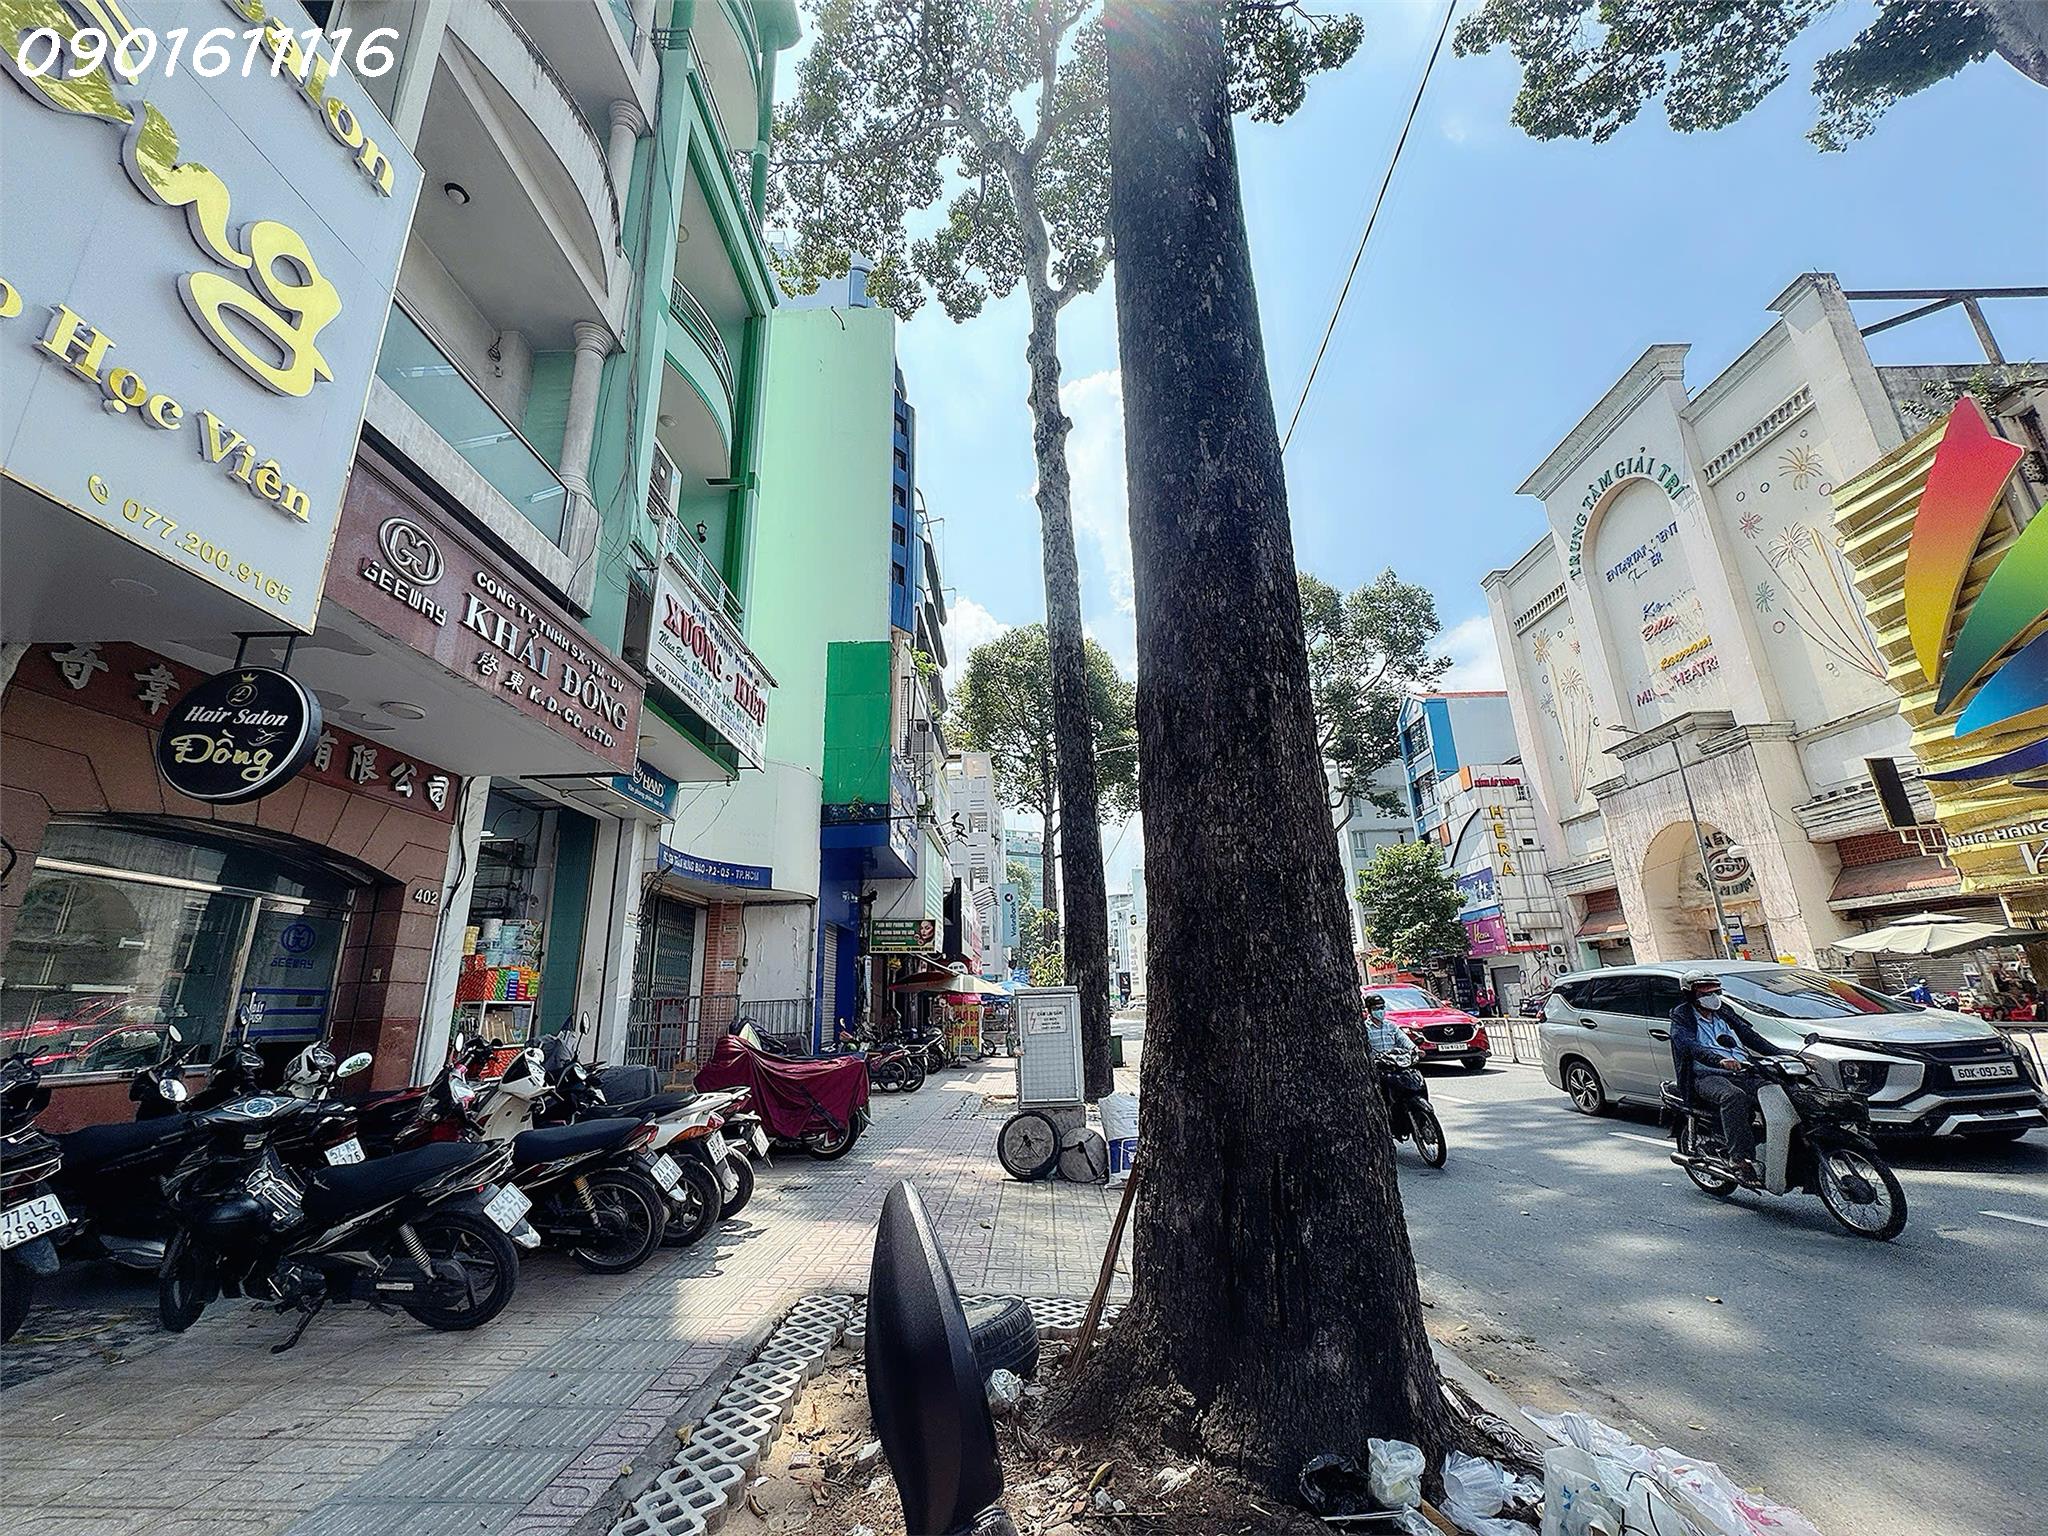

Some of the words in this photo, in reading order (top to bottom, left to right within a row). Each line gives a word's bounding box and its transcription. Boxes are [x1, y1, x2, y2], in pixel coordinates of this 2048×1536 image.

[36, 303, 184, 431] Học
[193, 408, 311, 523] Viên
[1583, 470, 1614, 510] TÂM
[1615, 447, 1655, 479] GIẢI
[122, 498, 293, 606] 077.200.9165
[476, 571, 516, 611] CÔNG
[516, 602, 537, 625] TY
[538, 618, 570, 653] TNHH
[462, 592, 552, 681] KHẢI
[561, 663, 628, 732] ĐÔNG
[184, 706, 232, 722] Hair
[233, 708, 289, 726] Salon
[170, 729, 273, 781] Đồng
[1489, 804, 1516, 877] HERA
[415, 888, 439, 904] 402
[1958, 1066, 2013, 1078] 60K-092.56
[1, 1200, 52, 1228] 77-L2
